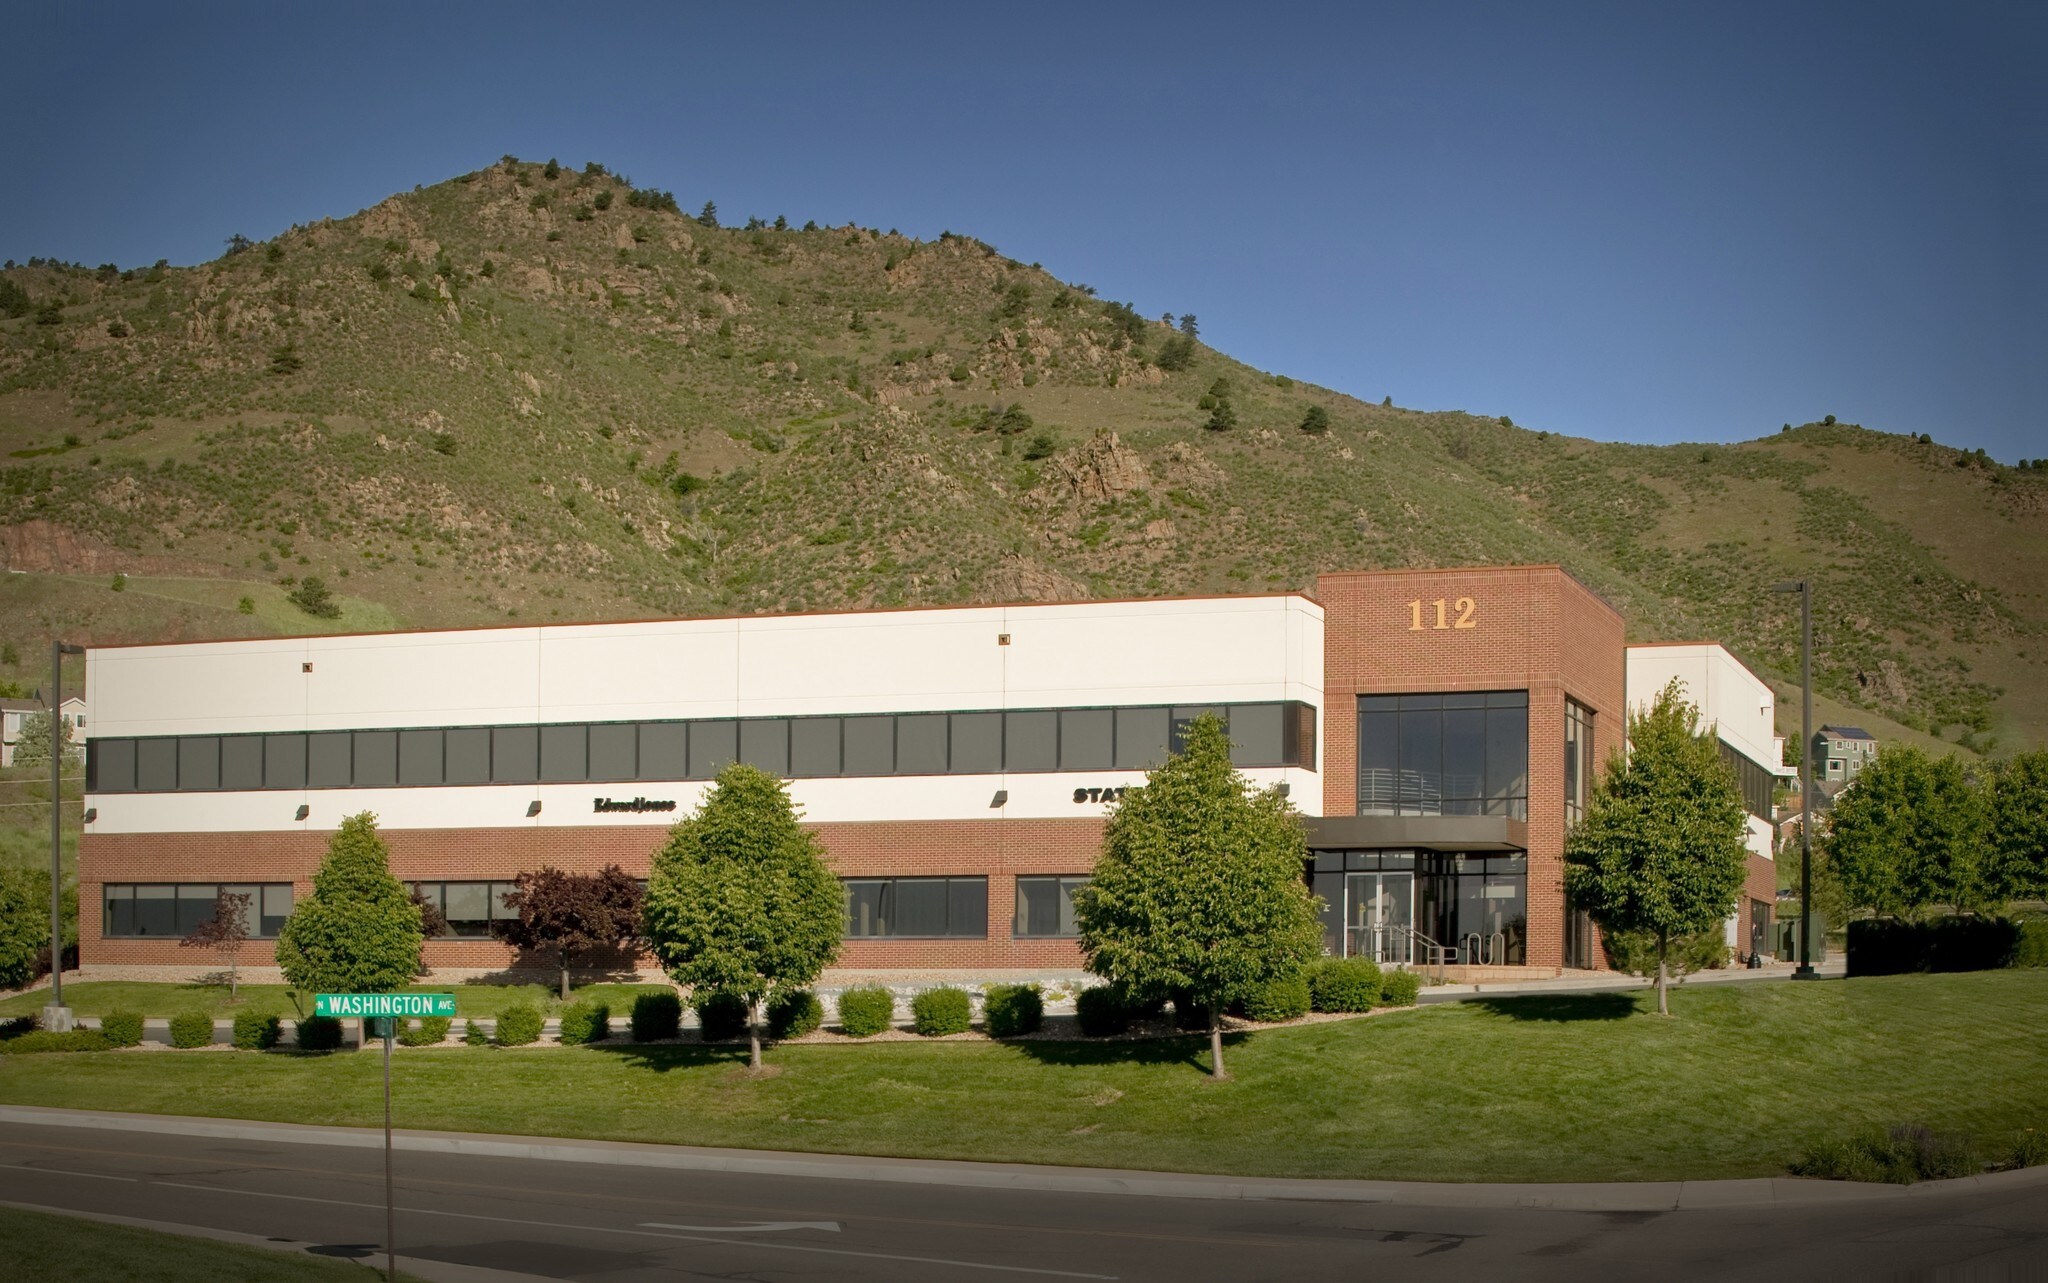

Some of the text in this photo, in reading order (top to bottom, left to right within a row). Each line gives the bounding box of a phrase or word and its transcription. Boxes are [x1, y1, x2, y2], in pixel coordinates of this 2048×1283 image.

[1407, 597, 1477, 631] 112
[317, 996, 452, 1014] N WASHINGTON AVE
